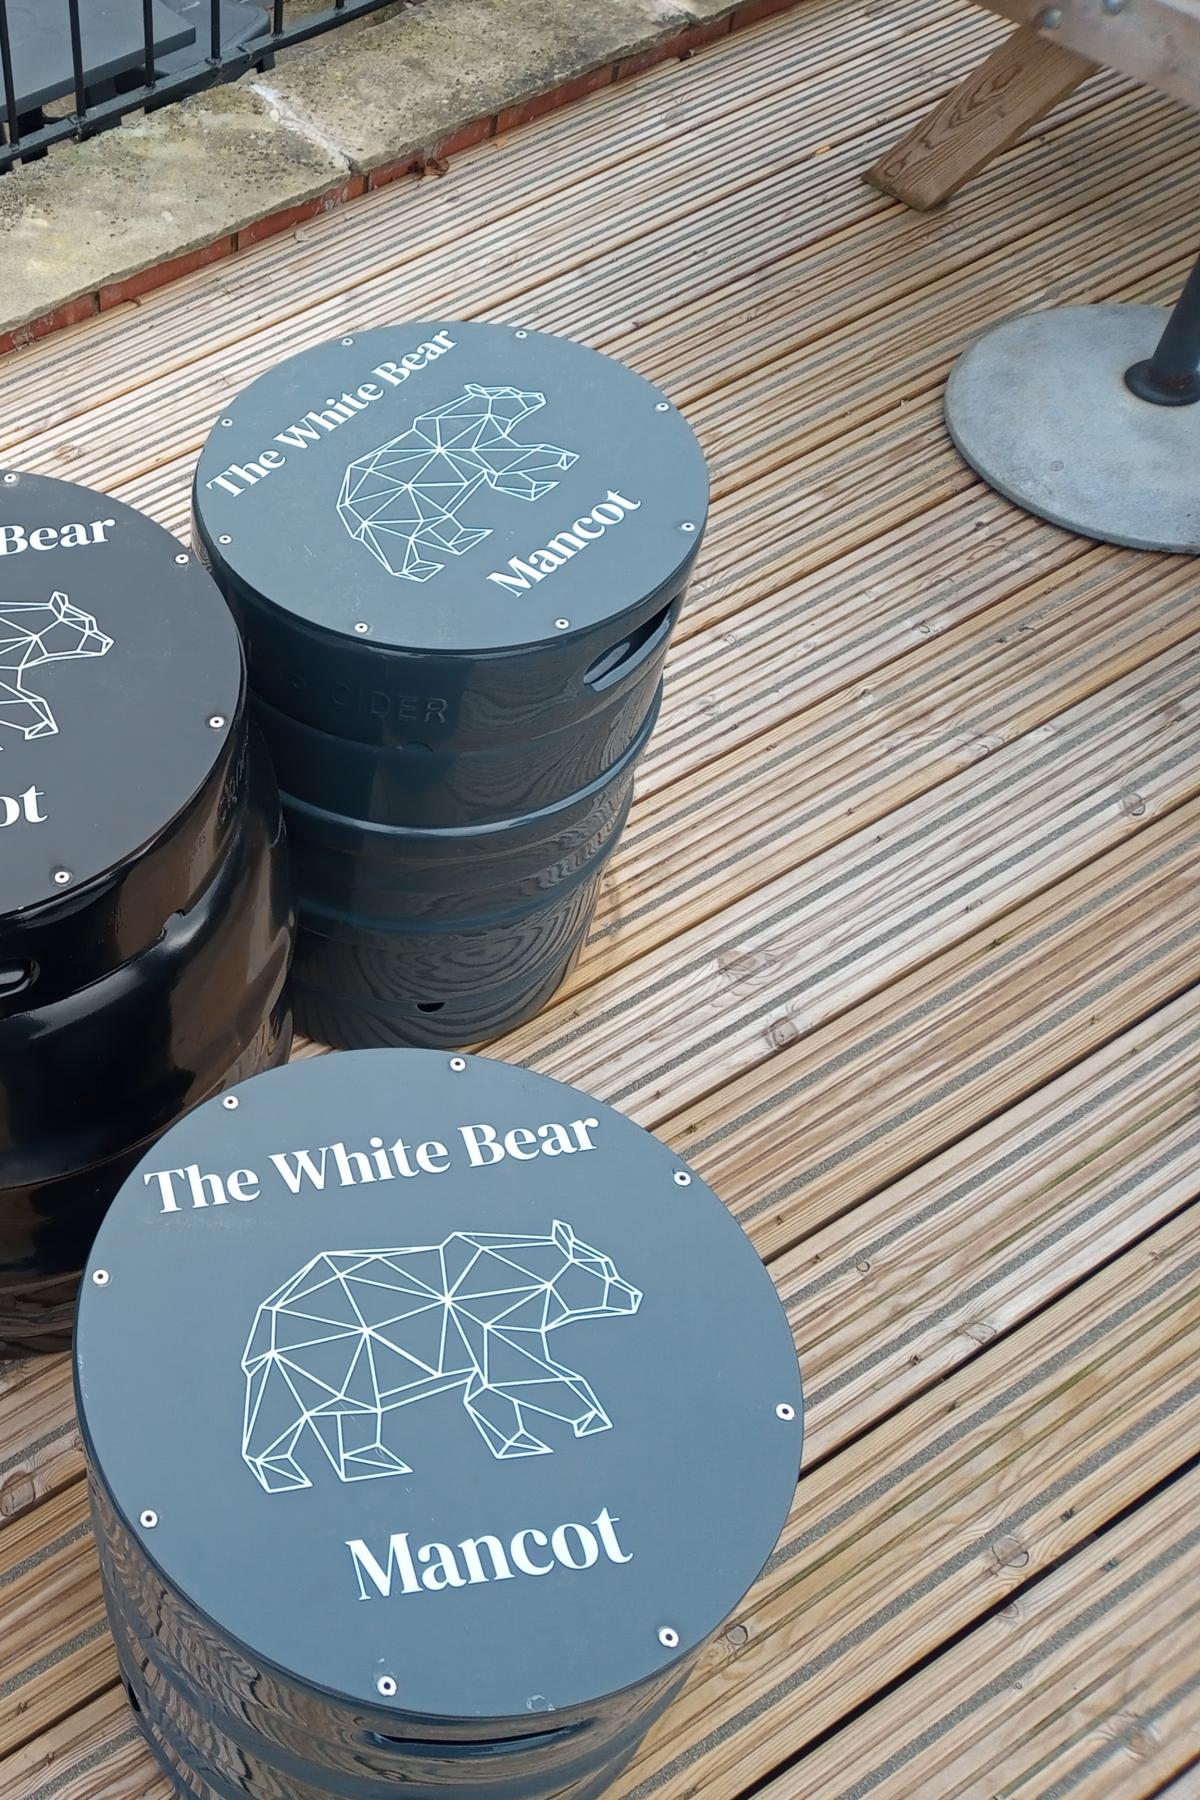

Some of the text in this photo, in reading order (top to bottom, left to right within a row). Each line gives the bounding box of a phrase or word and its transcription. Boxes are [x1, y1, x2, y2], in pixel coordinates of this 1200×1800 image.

[206, 329, 458, 498] The White Bear
[485, 488, 642, 598] Mancot
[144, 1116, 599, 1215] The White Bear
[346, 1508, 634, 1601] Mancot
